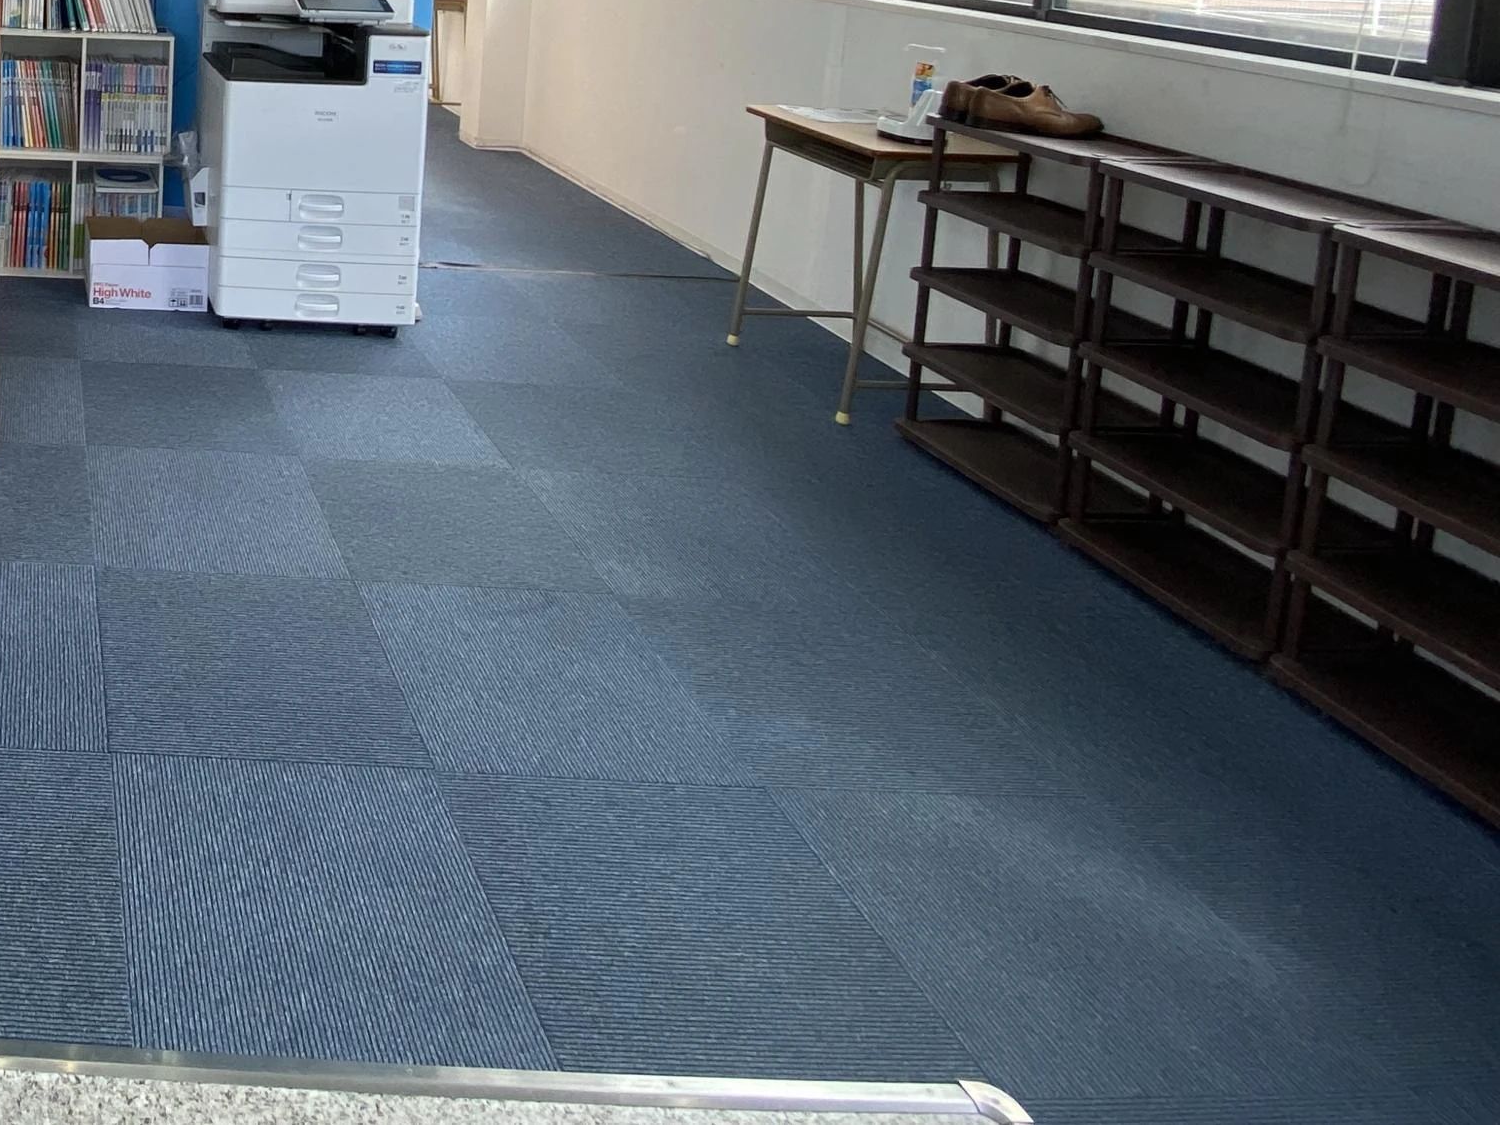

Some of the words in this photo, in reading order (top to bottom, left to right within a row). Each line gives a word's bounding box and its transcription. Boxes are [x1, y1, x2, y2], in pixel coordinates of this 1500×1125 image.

[93, 287, 118, 299] High
[119, 287, 152, 299] White
[92, 296, 105, 305] B4
